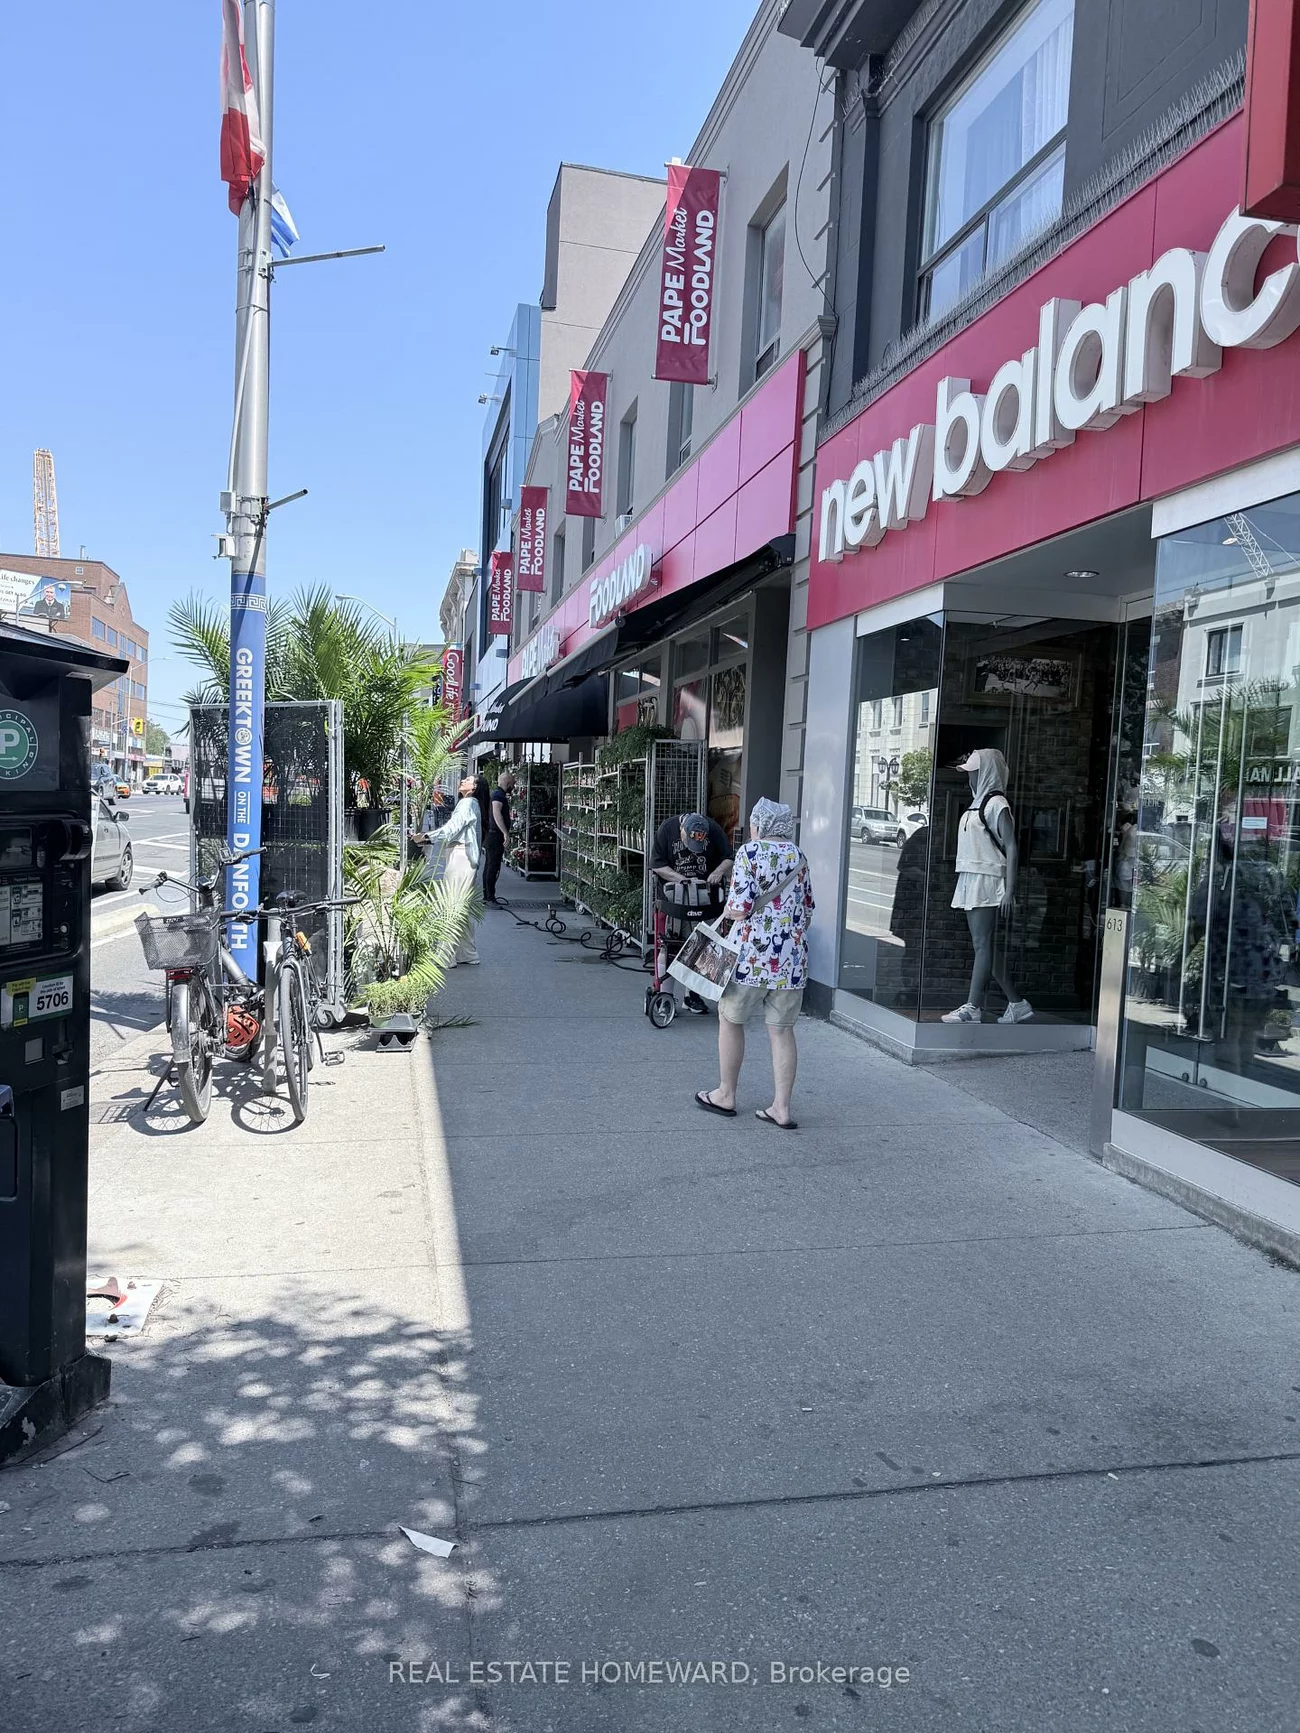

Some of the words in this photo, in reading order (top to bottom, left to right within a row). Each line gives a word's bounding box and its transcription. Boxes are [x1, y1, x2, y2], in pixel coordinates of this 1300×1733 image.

[666, 206, 688, 271] Market
[683, 209, 714, 346] FOODLAND
[661, 273, 685, 343] PAPE
[818, 424, 930, 563] new
[932, 204, 1300, 501] balanc
[571, 399, 586, 442] Market
[584, 401, 604, 493] FOODLAND
[569, 444, 585, 491] PAPE
[521, 508, 532, 540] Market
[531, 508, 546, 576] FOODLAND
[520, 541, 532, 575] PAPE
[491, 593, 501, 621] PAPE
[500, 568, 512, 622] FOODLAND
[589, 543, 648, 629] FOODLAND
[235, 648, 253, 783] GREEKTOWN
[236, 807, 246, 824] THE
[237, 791, 246, 806] ON
[231, 833, 250, 949] DNFOTH
[1106, 917, 1122, 932] 613
[37, 991, 68, 1010] 5706
